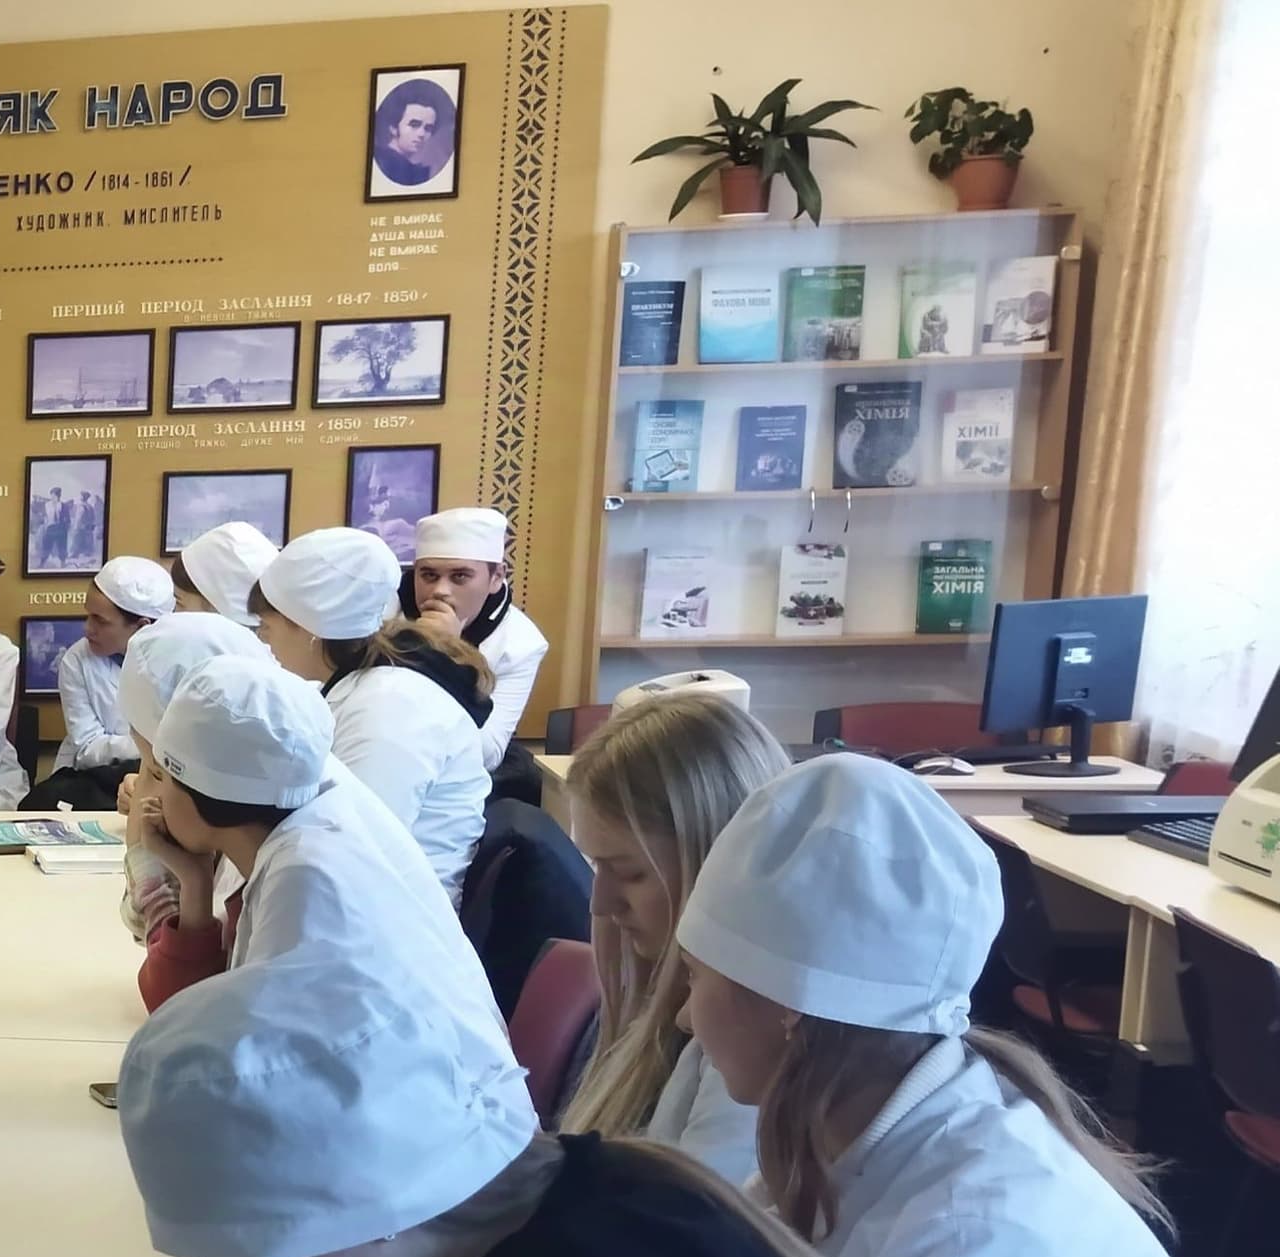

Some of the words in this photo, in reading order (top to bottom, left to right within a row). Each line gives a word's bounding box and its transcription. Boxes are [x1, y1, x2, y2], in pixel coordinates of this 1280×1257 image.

[84, 73, 288, 130] НАРОД
[123, 203, 222, 225] МИСЛИТЕЛЬ
[370, 216, 387, 226] НЕ
[369, 231, 405, 242] ДУША
[369, 247, 385, 257] НЕ
[52, 300, 125, 318] ПЕРШИЙ
[140, 299, 204, 315] ПЕРІОД
[219, 294, 313, 311] ЗАСЛАННЯ
[50, 423, 117, 442] ДРУГИЙ
[137, 423, 197, 438] ПЕРІОД
[214, 419, 306, 435] ЗАСЛАННЯ
[933, 566, 985, 574] ЗАГАЛЬНА
[932, 581, 984, 594] ХІМІЯ
[29, 592, 87, 604] ІСТОРІЯ
